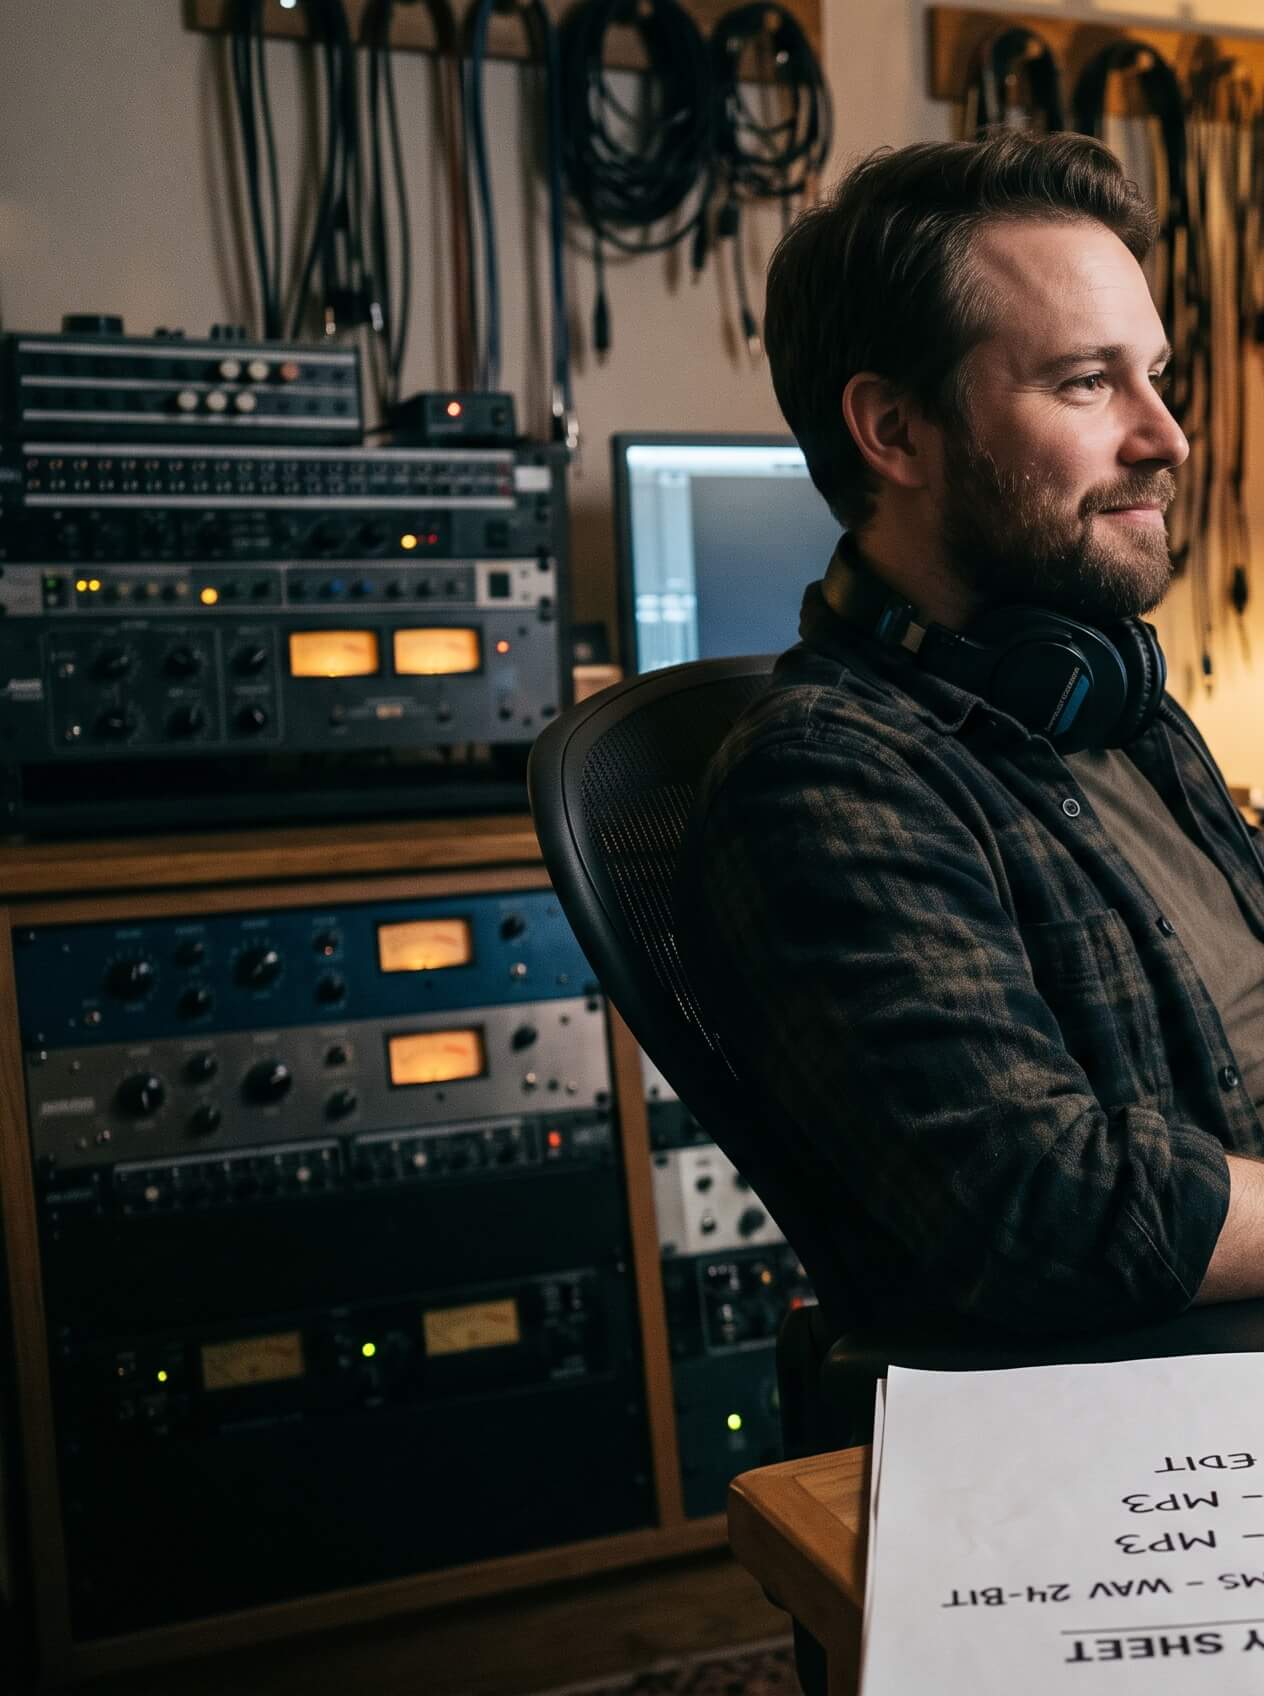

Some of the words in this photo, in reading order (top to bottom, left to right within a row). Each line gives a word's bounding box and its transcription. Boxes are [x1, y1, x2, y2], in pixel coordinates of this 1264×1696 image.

[1154, 1452, 1258, 1474] EDIT
[1121, 1490, 1219, 1514] MP3
[1114, 1529, 1217, 1555] MP3
[943, 1583, 1071, 1608] 24-BIT
[1089, 1577, 1173, 1599] WAV
[1065, 1632, 1224, 1663] SHEET
